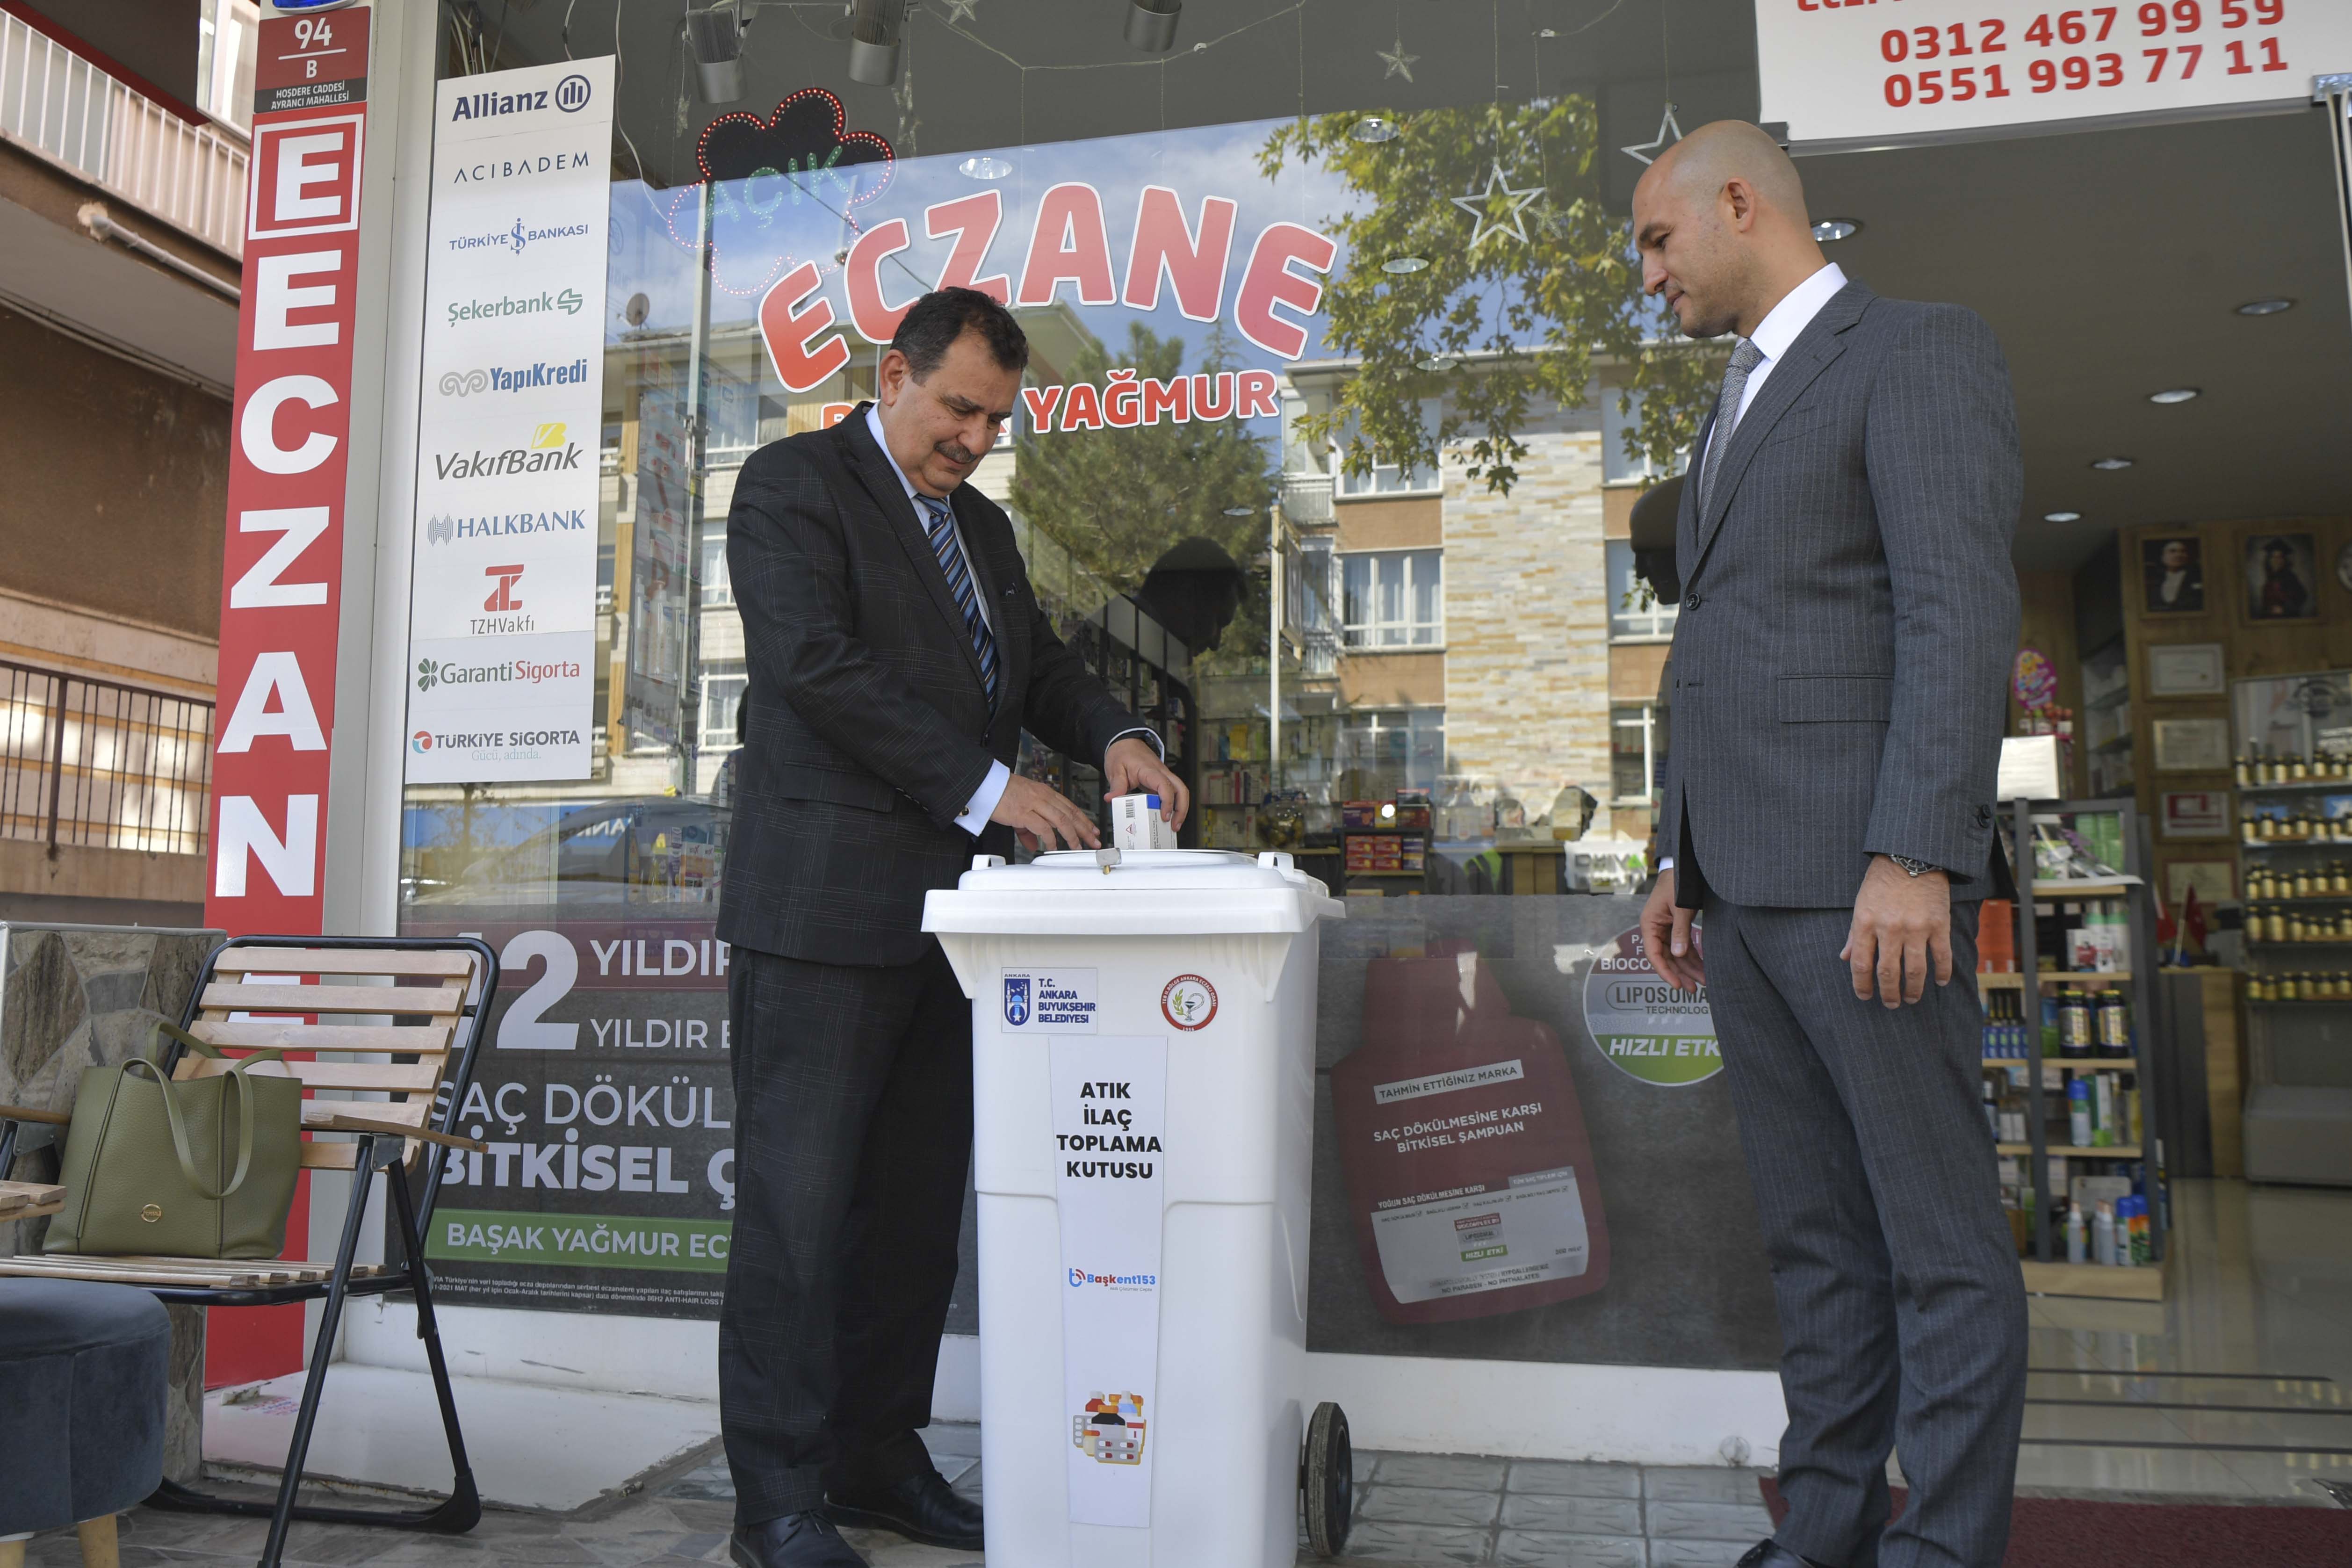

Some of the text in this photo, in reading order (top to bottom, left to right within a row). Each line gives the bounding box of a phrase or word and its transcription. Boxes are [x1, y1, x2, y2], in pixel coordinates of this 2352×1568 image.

[294, 19, 332, 50] 94
[1881, 0, 2284, 63] 0312 467 99 59
[306, 60, 317, 78] B
[1883, 37, 2288, 108] 0551 993 77 11
[271, 91, 349, 110] AYRANCI MAHALLESİ
[276, 80, 345, 99] HOŞDERE CADDESİ
[452, 90, 548, 122] Allianz
[274, 132, 344, 221] E
[454, 152, 589, 184] ACIBADEM
[703, 145, 849, 231] AÇIK
[449, 233, 508, 251] TÜRKİYE
[527, 224, 589, 242] BANKASI
[758, 181, 1338, 393] ECZANE
[447, 292, 553, 327] Şekerbank
[491, 359, 587, 393] YapıKredi
[1021, 368, 1280, 434] YAĞMUR
[435, 442, 584, 480] VakıfBank
[457, 509, 585, 538] HALKBANK
[470, 616, 534, 635] TZHVakfı
[435, 730, 580, 749] TÜRKİYE SİGORTA
[472, 747, 541, 762] Gücü, adında.
[1601, 958, 1653, 971] BIOCO
[1039, 978, 1055, 988] T.C.
[1039, 990, 1078, 999] ANKARA
[1645, 1006, 1708, 1014] TECHNOLOG
[590, 1019, 708, 1048] YILDIR
[1609, 1039, 1721, 1057] HIZLI ETK
[1080, 1082, 1131, 1099] ATIK
[1380, 1066, 1518, 1099] TAHMİN ETTİĞİNİZ MARKA
[431, 1075, 731, 1135] SAÇ DÖKÜL
[1084, 1104, 1132, 1131] İLAÇ
[1374, 1102, 1542, 1144] SAÇ DÖKÜLMESİNE KARŞI
[1397, 1121, 1524, 1153] BİTKİSEL ŞAMPUAN
[1056, 1134, 1162, 1153] TOPLAMA
[428, 1125, 689, 1193] BİTKİSEL
[1066, 1161, 1153, 1179] KUTUSU
[1402, 1195, 1416, 1206] SAÇ
[448, 1223, 732, 1259] BAŞAK YAĞMUR EC
[1087, 1274, 1155, 1286] Başkent153
